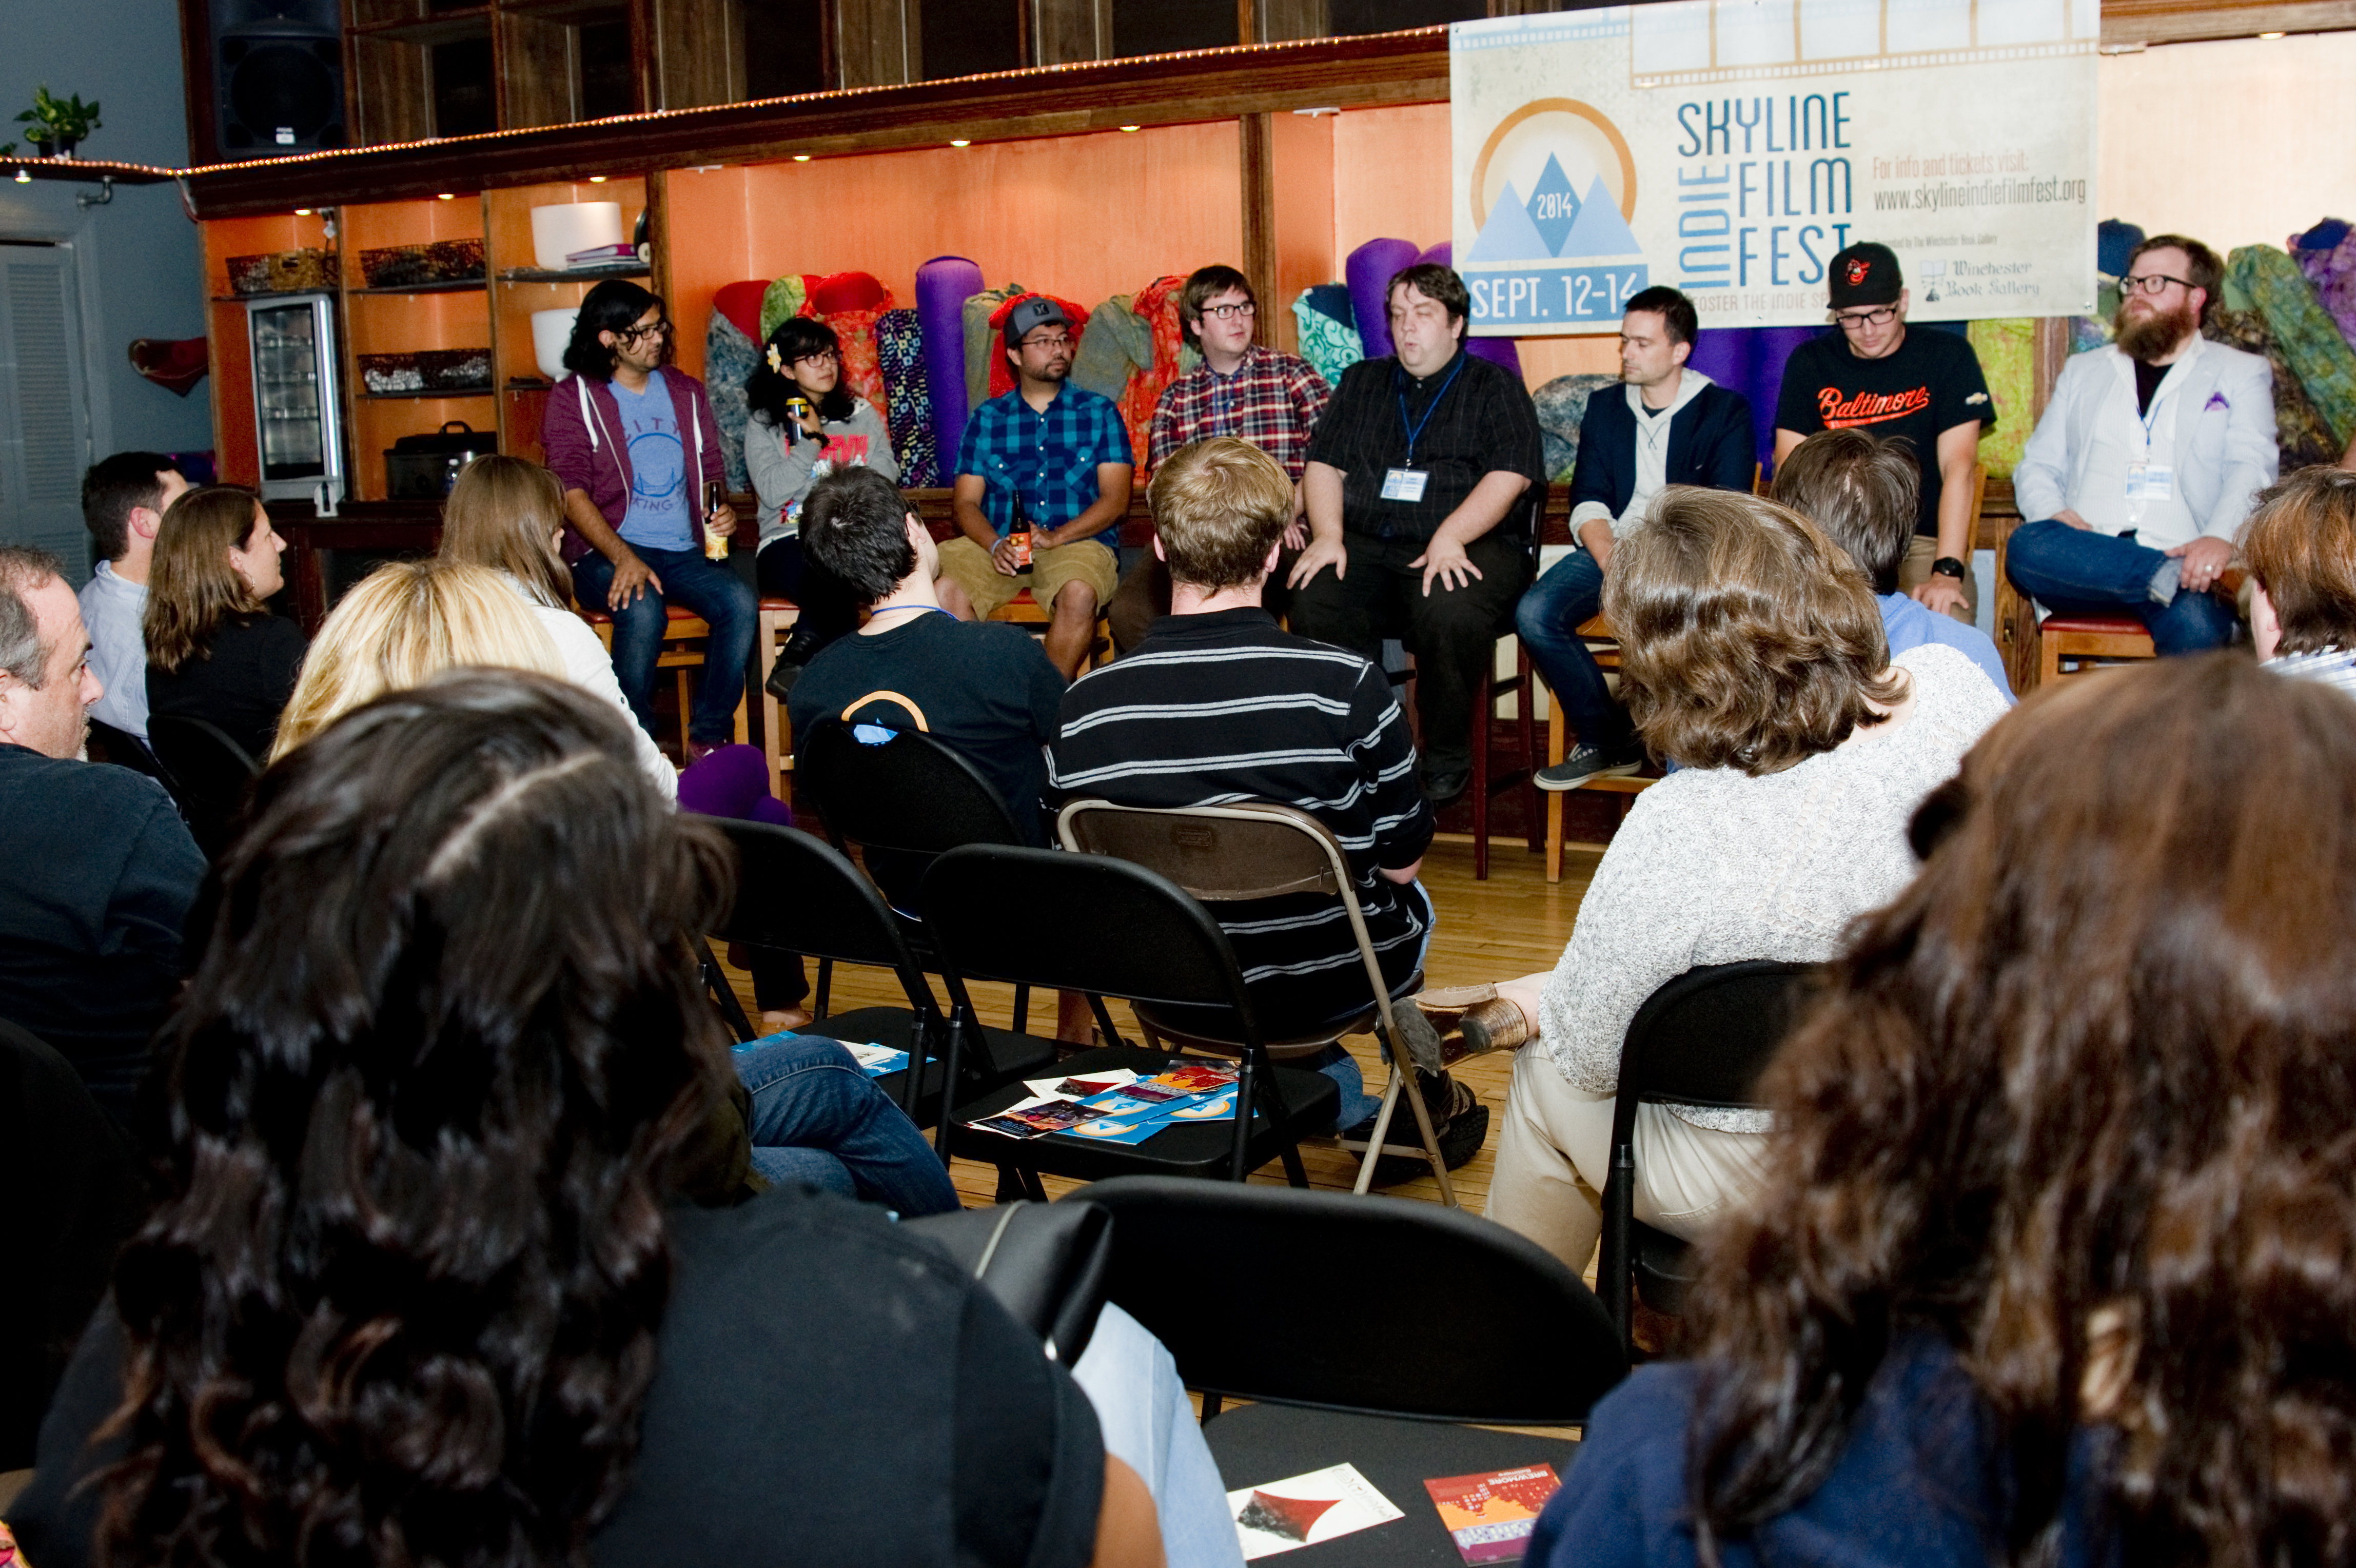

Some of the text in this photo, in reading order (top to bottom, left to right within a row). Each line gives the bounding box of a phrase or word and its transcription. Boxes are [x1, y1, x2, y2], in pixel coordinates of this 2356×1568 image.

[1677, 91, 1851, 157] SKYLINE
[1873, 149, 2030, 180] For info and tickets visit:
[1739, 156, 1852, 218] FILM
[1874, 175, 2087, 212] www.skylineindiefilmfest.org
[1536, 192, 1574, 220] 2014
[1678, 163, 1731, 289] INDIE
[1739, 223, 1852, 287] FEST
[1953, 260, 2032, 276] Winchester
[1470, 272, 1638, 318] SEPT. 12-14
[1743, 293, 1766, 310] THE
[1772, 292, 1807, 309] INDIE
[1945, 278, 2040, 297] Book Gallery
[1817, 386, 1930, 421] Baltimore
[1488, 1471, 1548, 1486] BREWMORE
